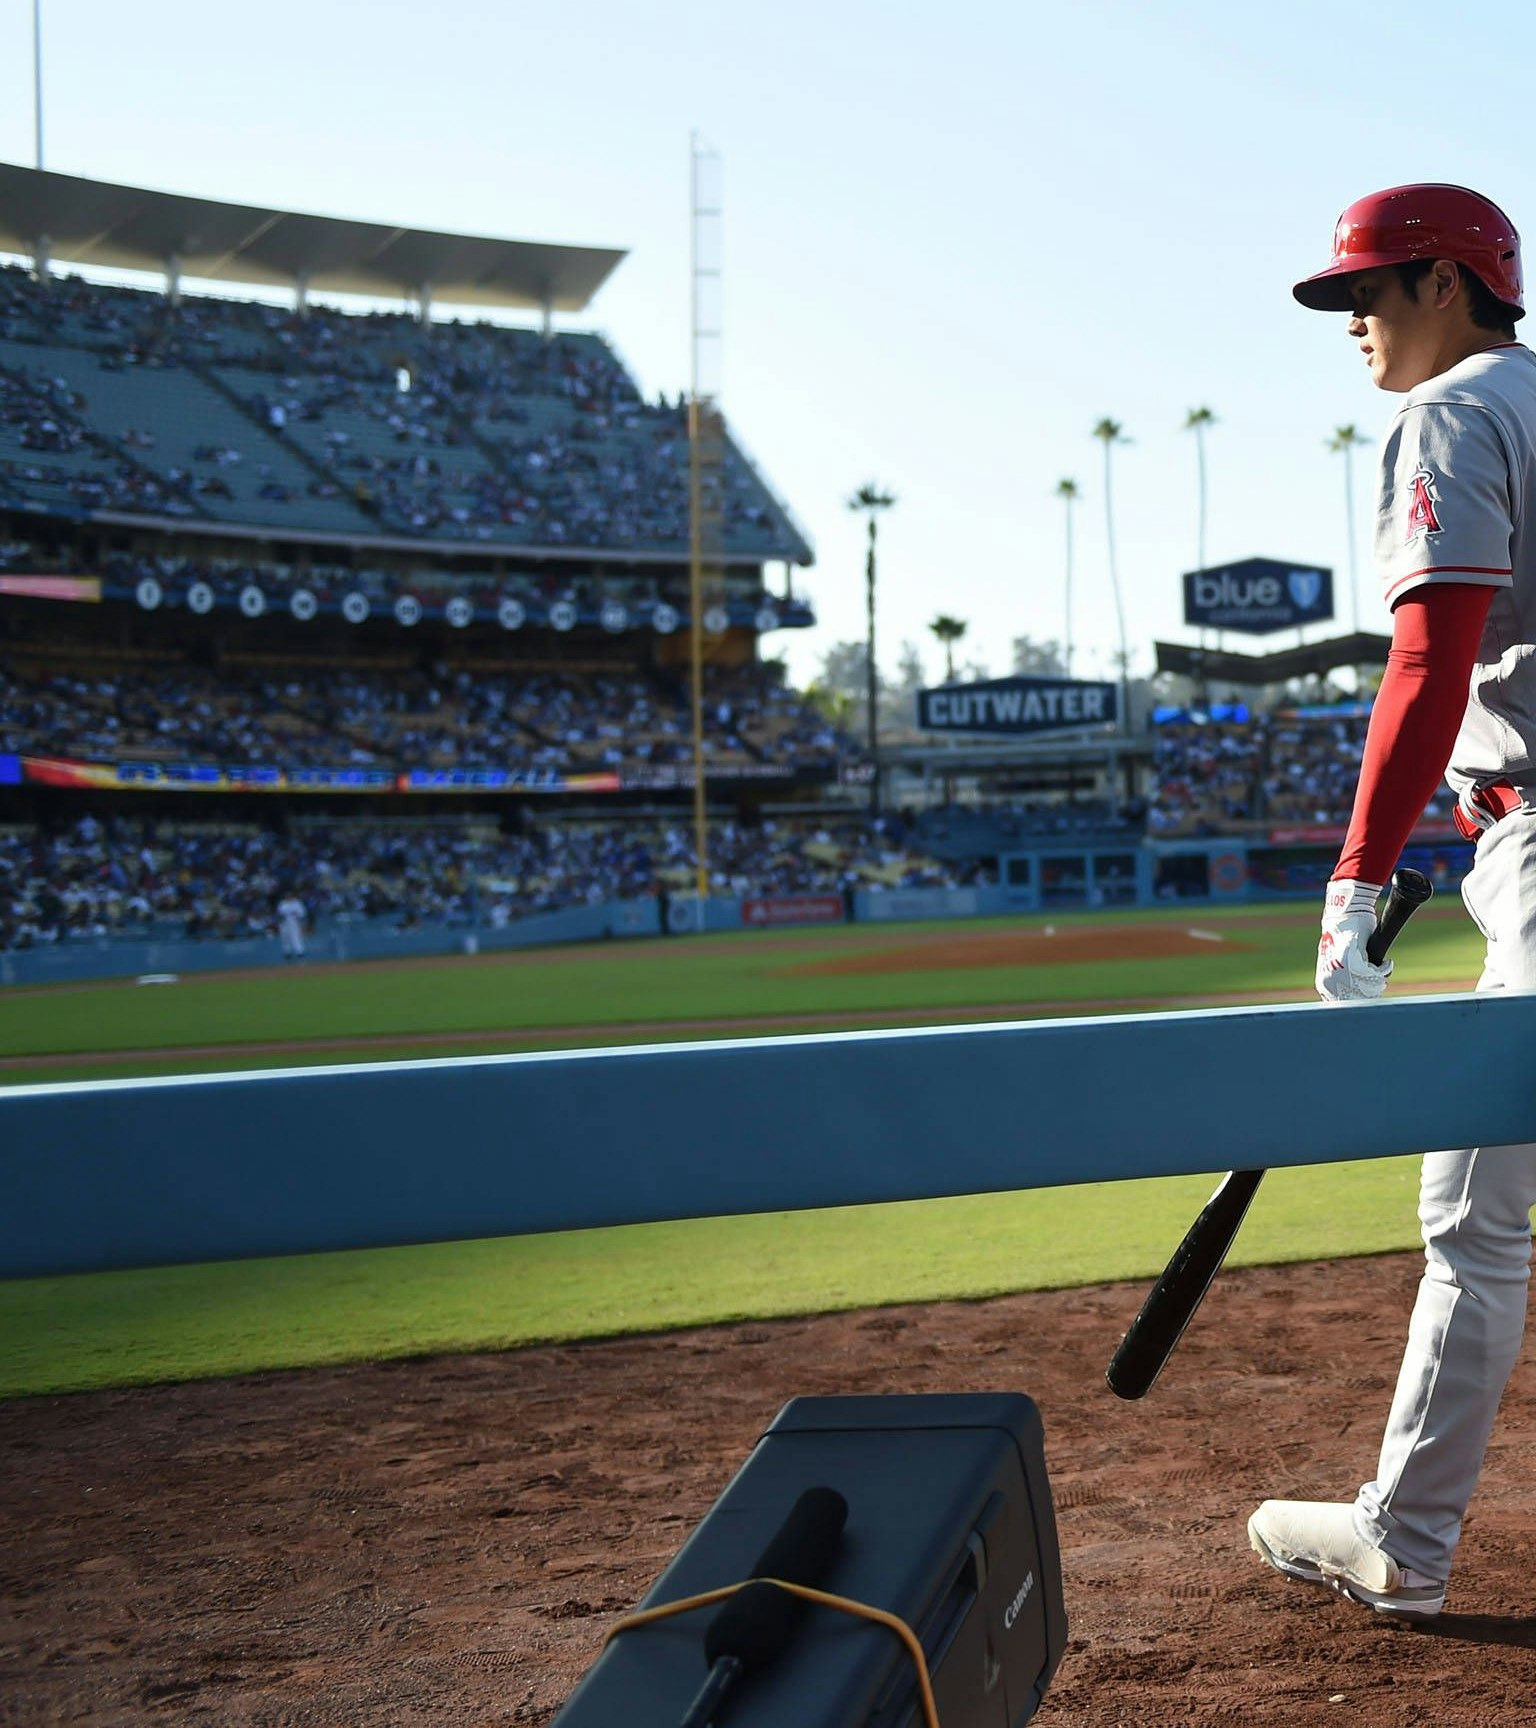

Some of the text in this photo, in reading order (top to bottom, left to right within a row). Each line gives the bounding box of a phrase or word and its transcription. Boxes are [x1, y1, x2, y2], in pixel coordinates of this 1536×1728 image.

[1195, 572, 1282, 608] blue
[928, 687, 1104, 725] CUTWATER
[1005, 1571, 1034, 1629] Canon
